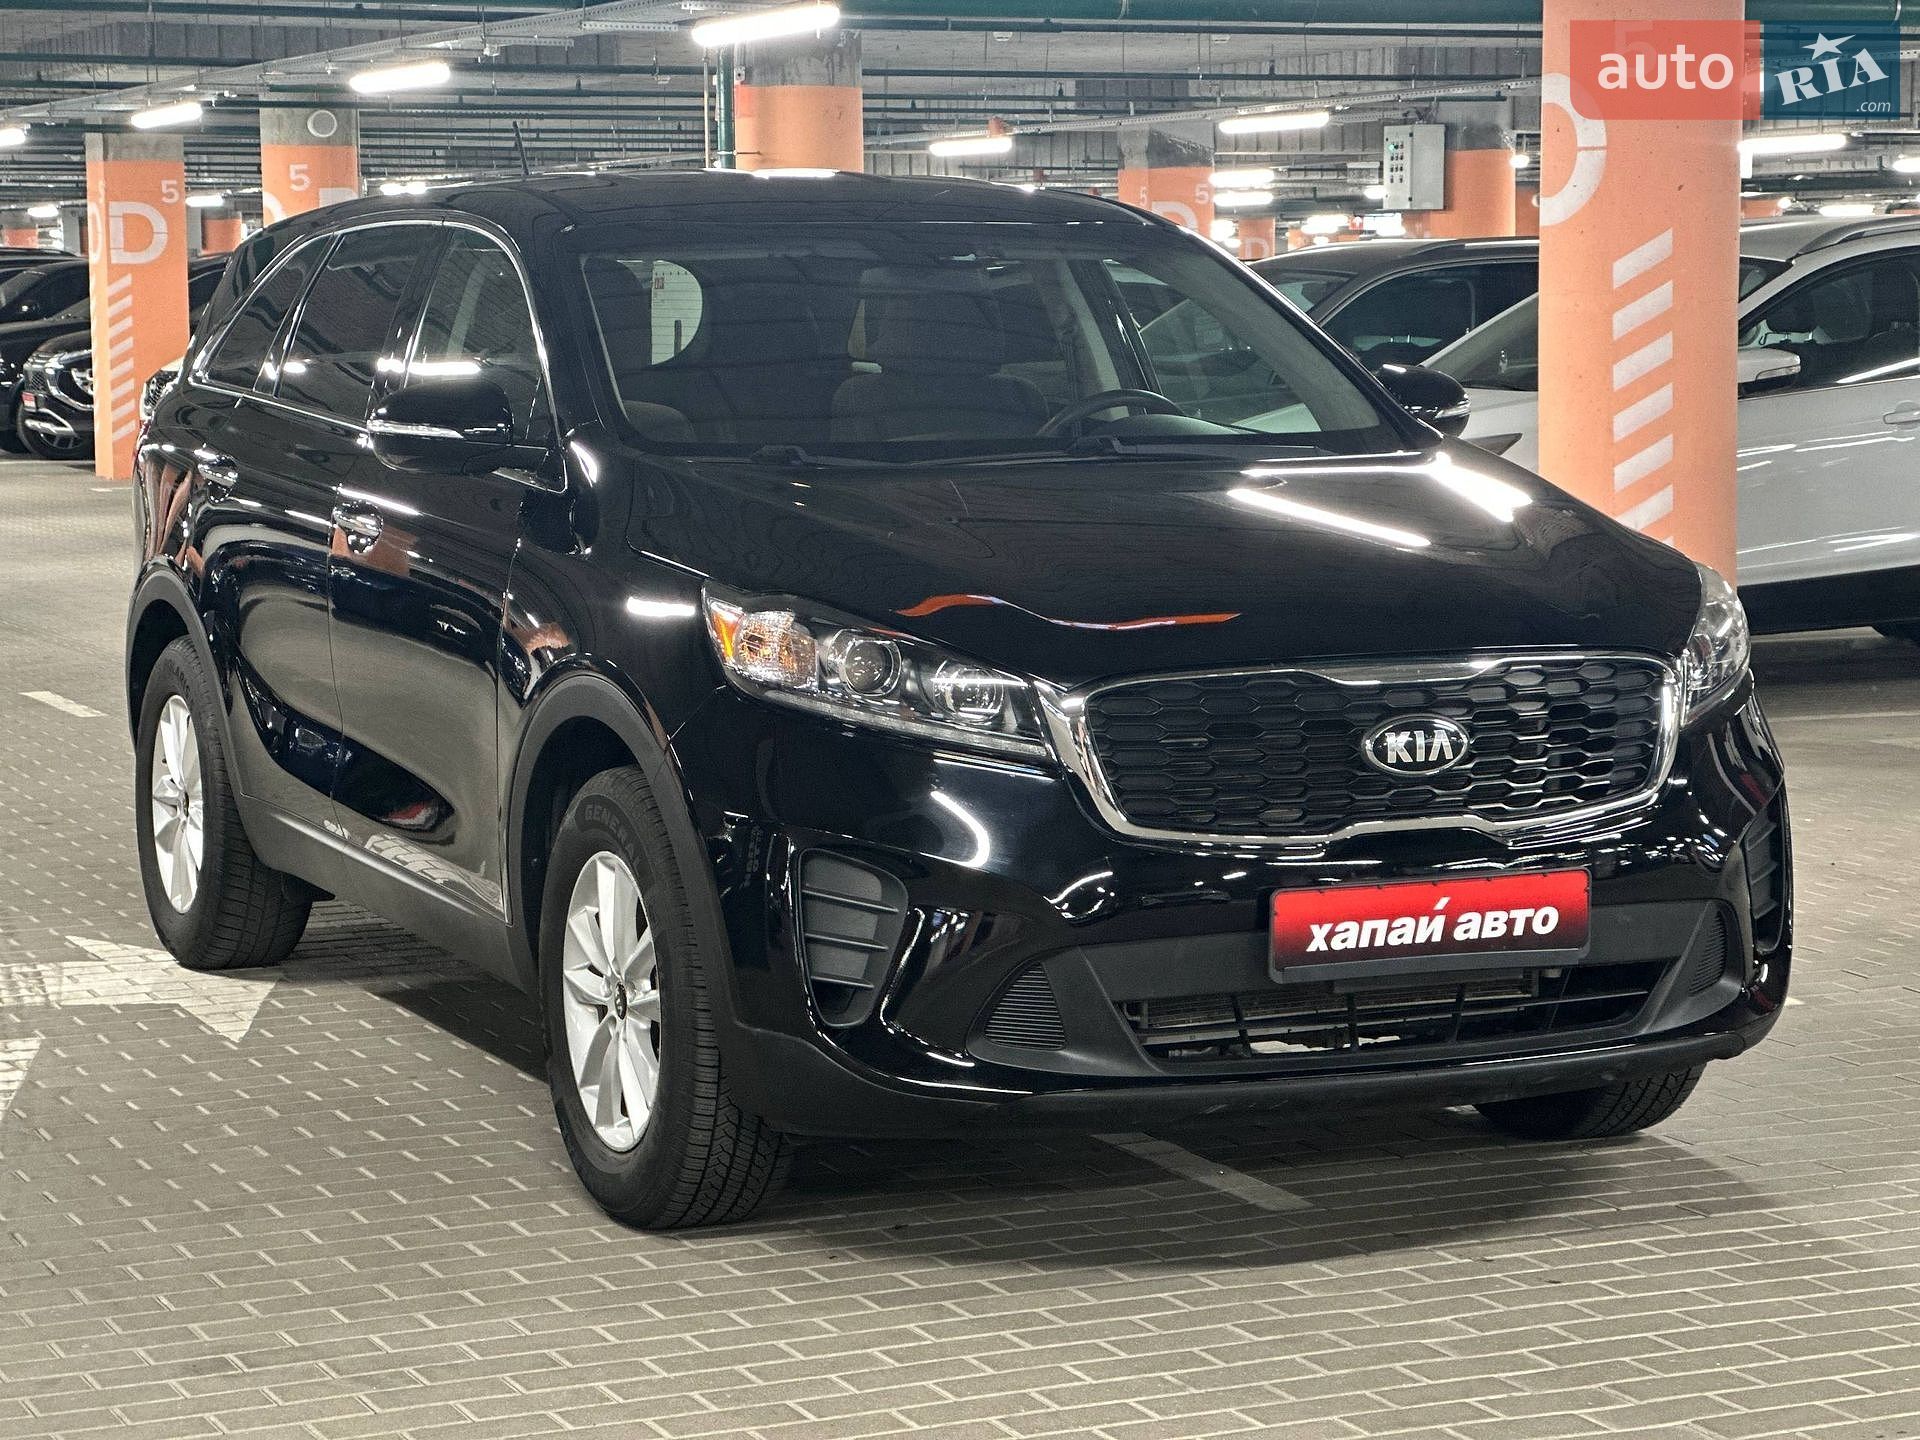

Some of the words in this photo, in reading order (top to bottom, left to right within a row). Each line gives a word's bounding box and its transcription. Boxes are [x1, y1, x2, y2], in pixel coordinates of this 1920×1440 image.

[161, 180, 179, 204] 5
[289, 163, 311, 192] 5
[1195, 184, 1209, 204] 5
[109, 201, 168, 264] D
[1385, 730, 1454, 763] KIA
[1453, 906, 1559, 941] авто
